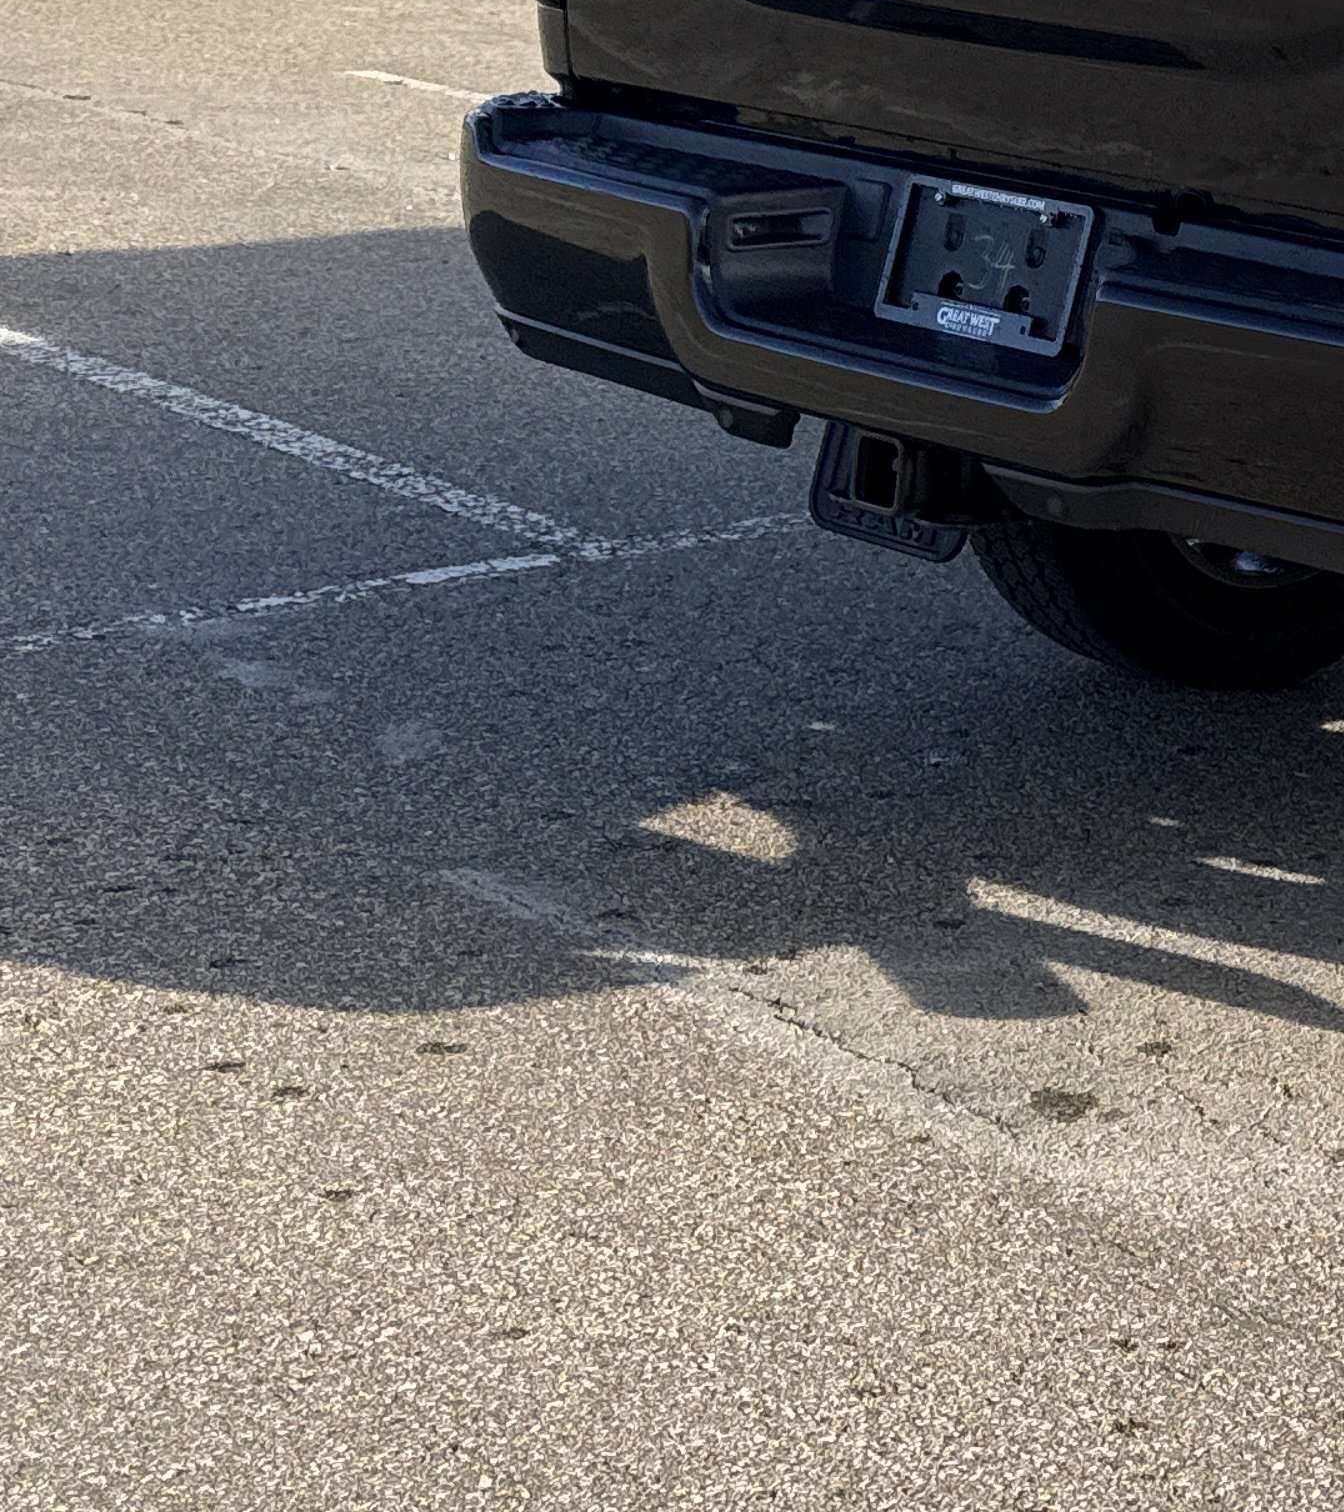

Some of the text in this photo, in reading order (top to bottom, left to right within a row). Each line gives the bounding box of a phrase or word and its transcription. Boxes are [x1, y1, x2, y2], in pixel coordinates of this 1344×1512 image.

[969, 234, 1016, 292] 34
[937, 306, 1001, 336] GREAT WEST
